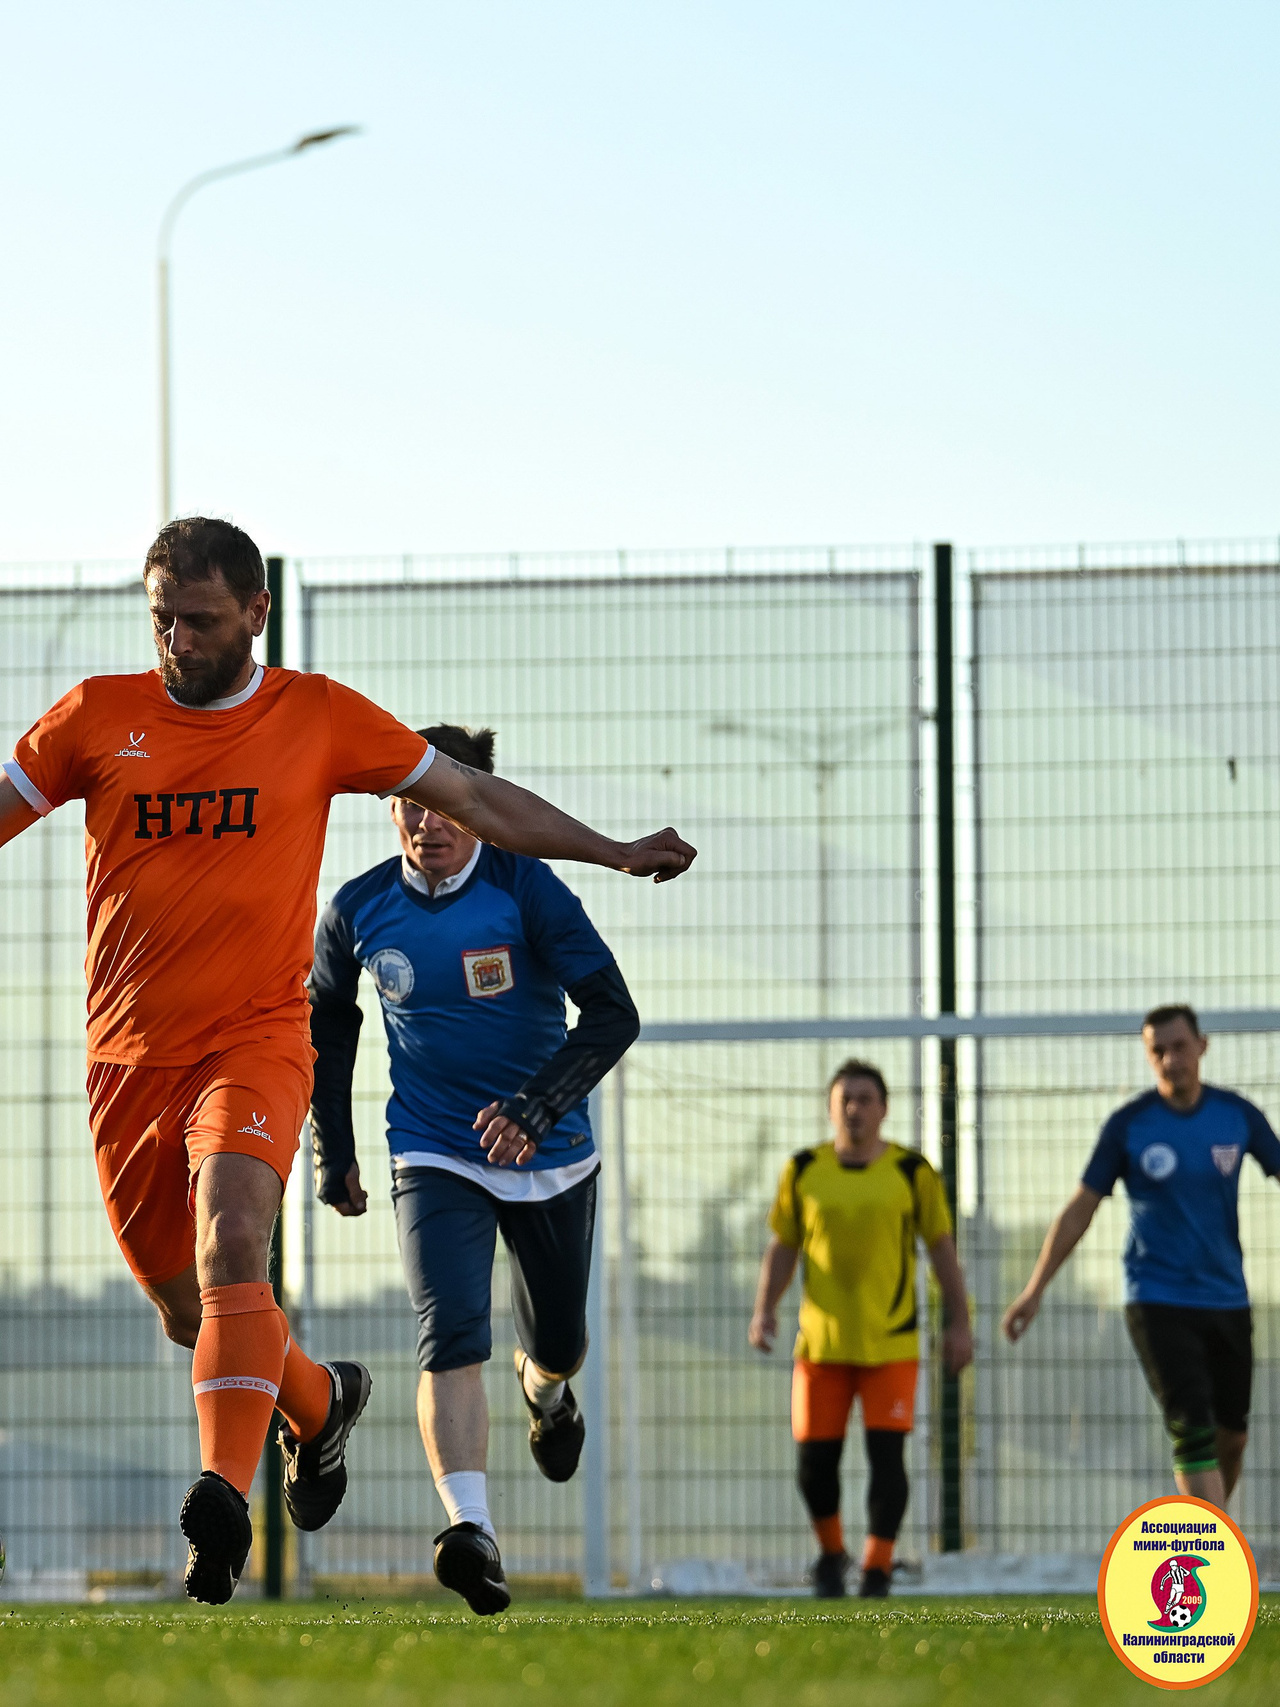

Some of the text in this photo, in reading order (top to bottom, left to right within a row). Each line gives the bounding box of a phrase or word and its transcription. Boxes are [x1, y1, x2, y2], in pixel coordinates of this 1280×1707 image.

[115, 748, 150, 758] JÖGEL
[133, 788, 259, 839] НТД
[237, 1126, 274, 1143] JÖGEL
[213, 1378, 273, 1392] JÖGEL
